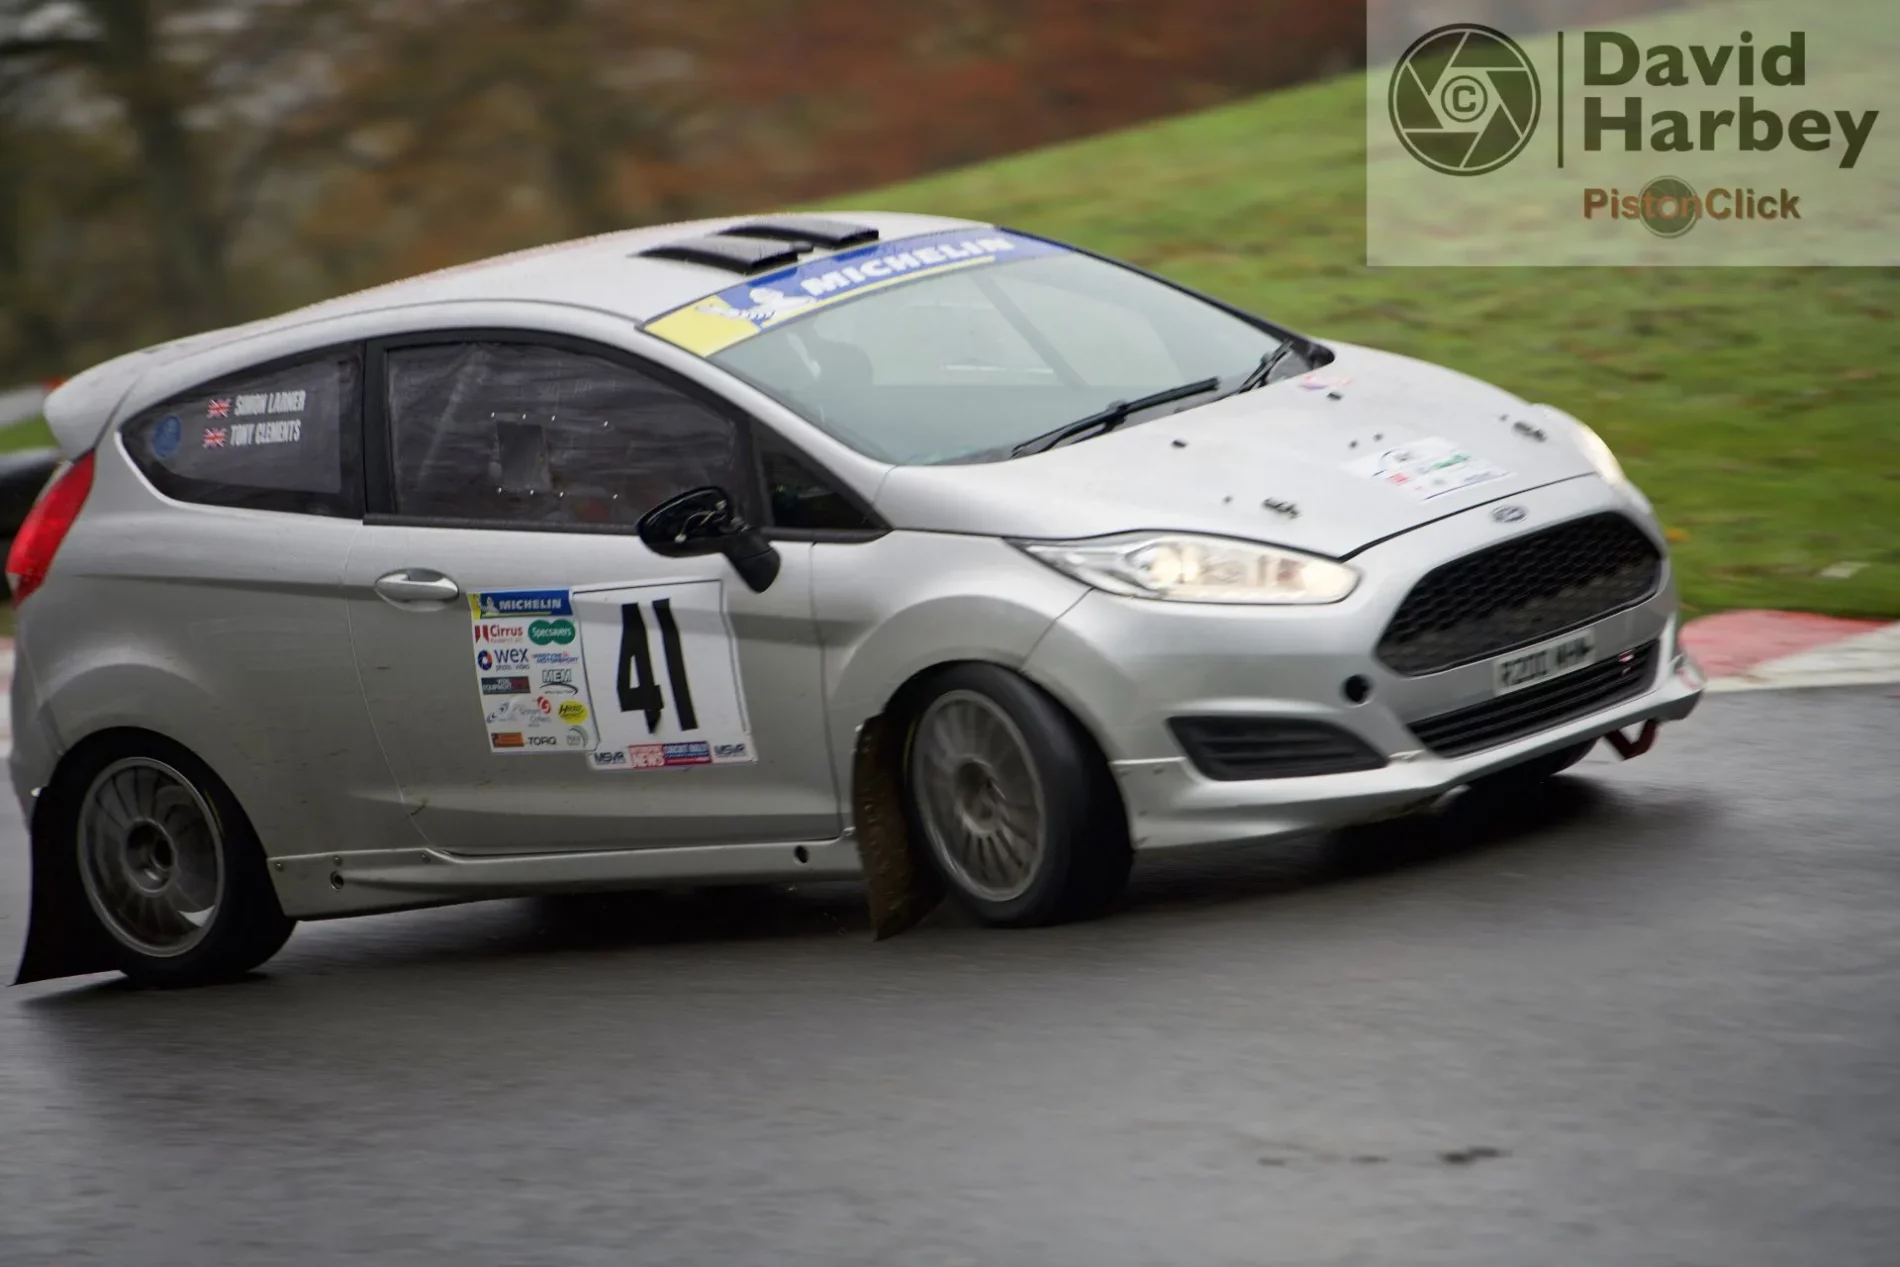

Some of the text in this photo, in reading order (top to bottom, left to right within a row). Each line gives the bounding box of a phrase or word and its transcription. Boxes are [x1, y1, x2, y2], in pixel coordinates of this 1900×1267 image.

[801, 236, 1016, 297] MICHELIN
[255, 419, 301, 444] CLEMENTS
[499, 598, 562, 610] MICHELIN
[490, 624, 524, 637] Cirrus
[531, 626, 573, 638] Specsavers
[494, 647, 530, 663] wex
[617, 598, 699, 734] 41
